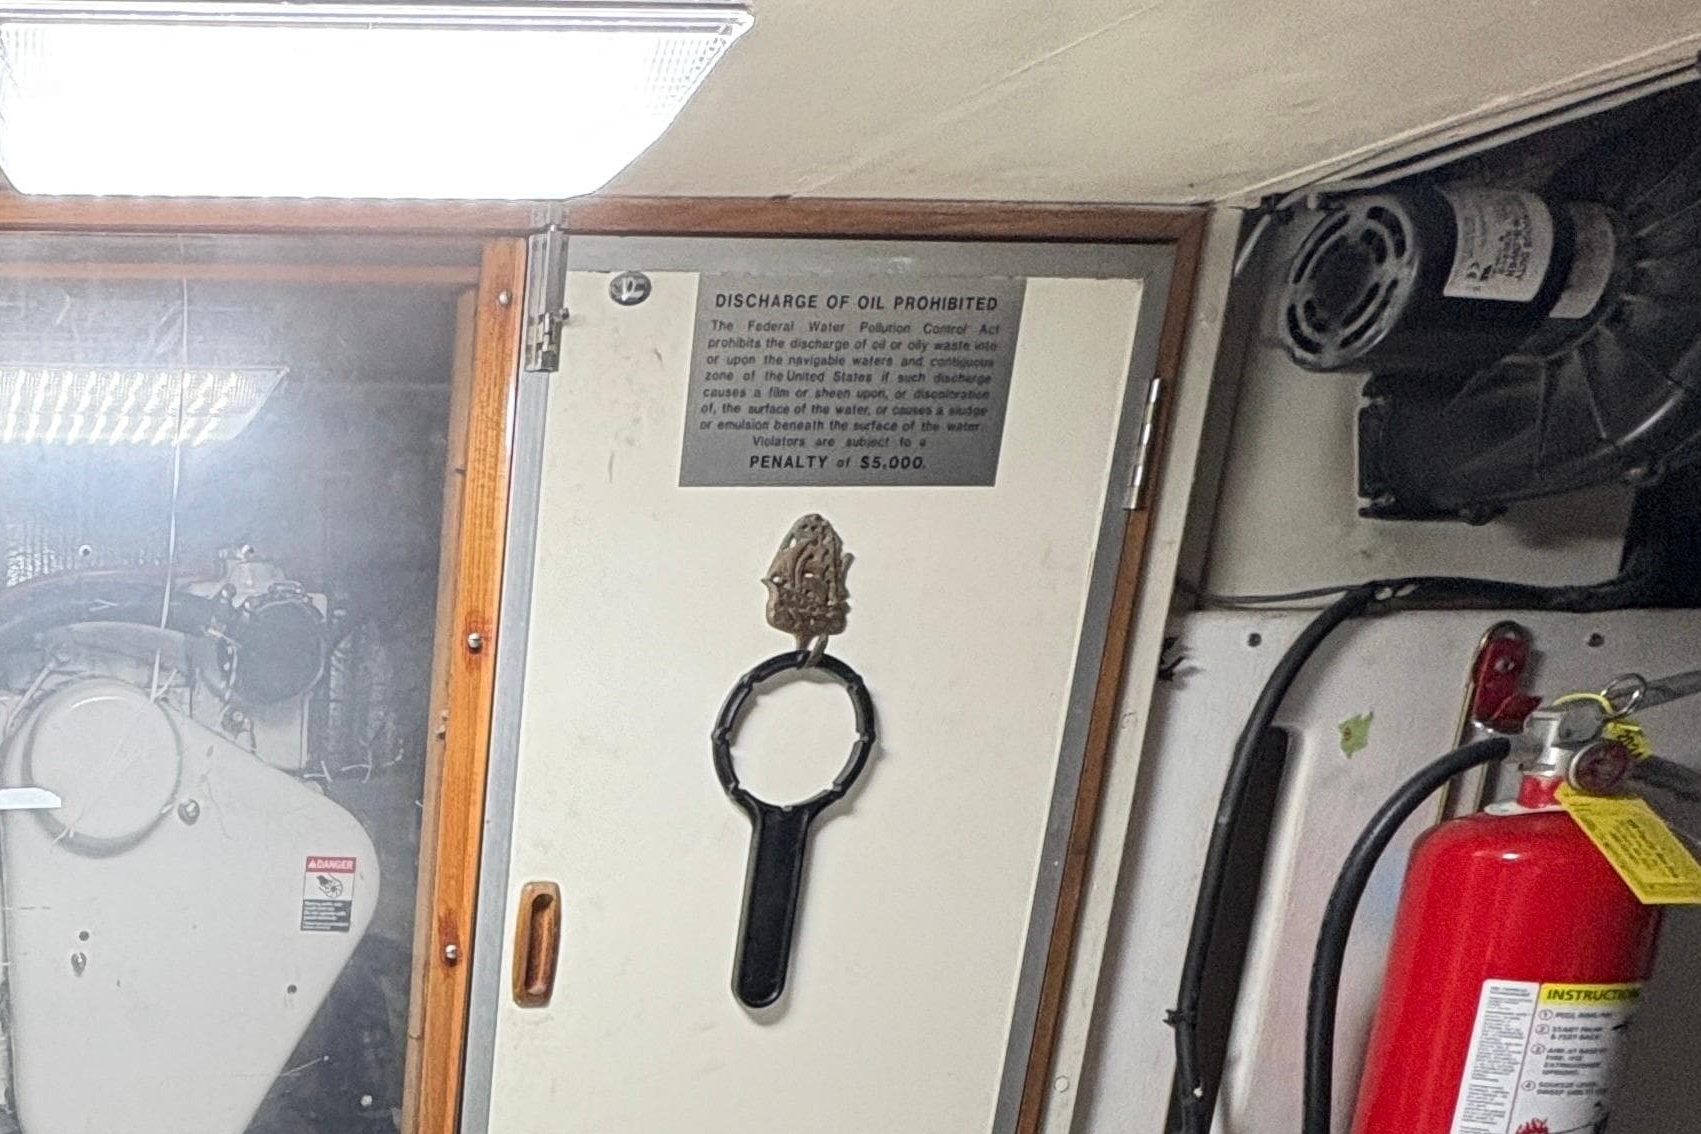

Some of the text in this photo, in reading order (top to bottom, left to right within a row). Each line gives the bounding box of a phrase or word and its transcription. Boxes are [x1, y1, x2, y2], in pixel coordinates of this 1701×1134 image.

[715, 293, 998, 311] DISCHARGE OF OIL PROHIBITED
[711, 319, 1000, 336] The Federal Water Pollution Control Act
[707, 336, 998, 353] prohibits the discharge of oil or oily waste into
[706, 355, 719, 365] or
[726, 356, 756, 368] upon
[764, 355, 783, 366] the
[788, 356, 846, 368] navigable
[852, 357, 893, 367] waters
[901, 357, 924, 367] and
[705, 370, 992, 385] zone of the United States if such discharge
[702, 388, 746, 398] causes
[754, 388, 761, 398] a
[768, 387, 790, 398] film
[795, 388, 809, 398] or
[815, 387, 851, 399] sheen
[894, 390, 907, 400] or
[722, 403, 741, 414] the
[748, 403, 790, 415] surface
[794, 403, 807, 414] of
[811, 404, 830, 414] the
[876, 406, 888, 415] or
[892, 406, 932, 416] causes
[936, 407, 944, 416] a
[700, 420, 712, 430] or
[717, 419, 769, 430] emulsion
[773, 420, 824, 431] beneath
[829, 420, 848, 431] the
[853, 420, 898, 431] surface
[902, 420, 915, 431] of
[921, 421, 940, 431] the
[753, 435, 927, 449] Violators are subject to a
[749, 455, 828, 469] PENALTY
[836, 457, 851, 468] of
[317, 859, 354, 870] DANGER
